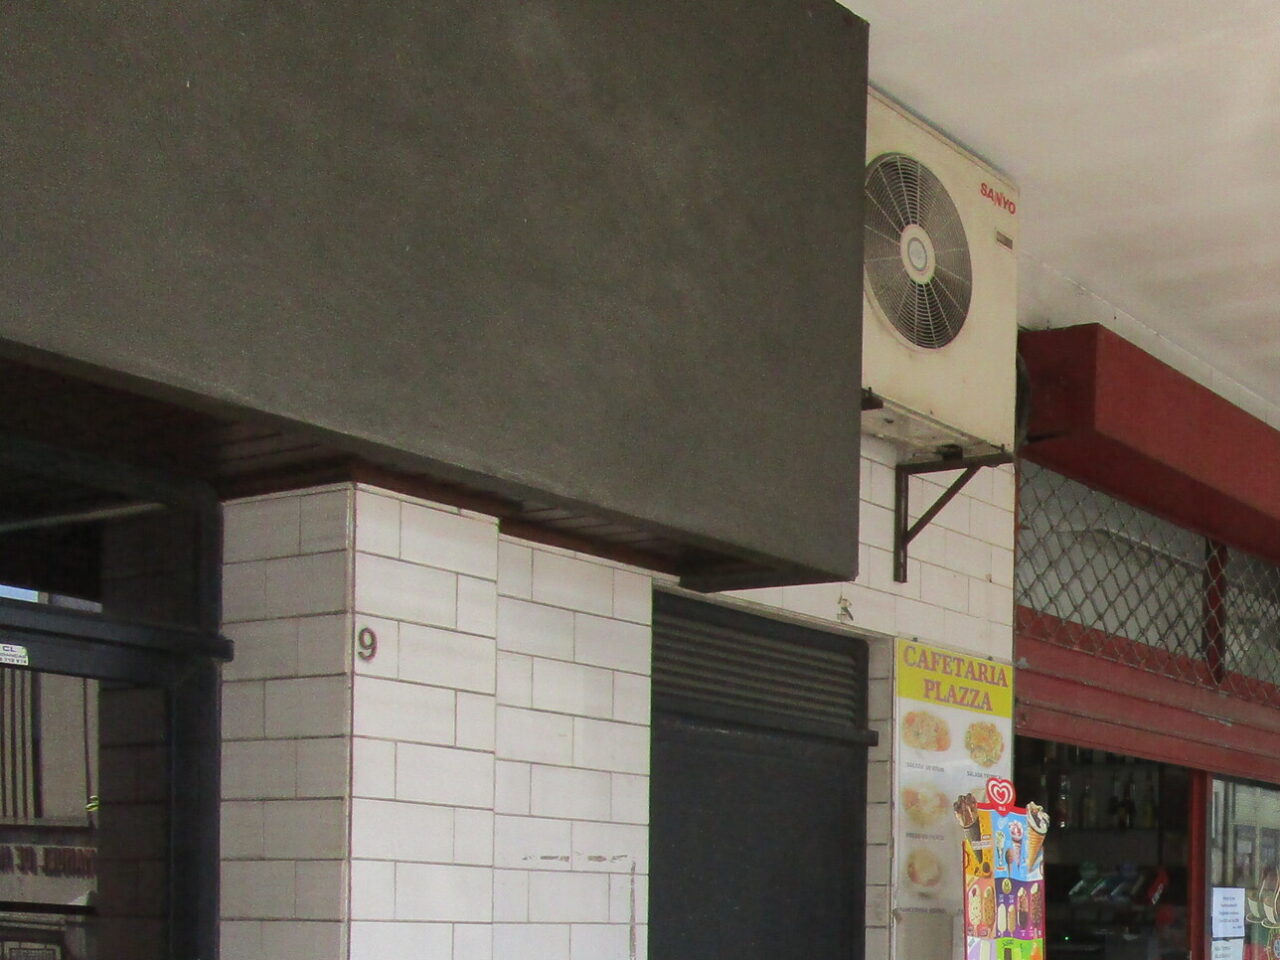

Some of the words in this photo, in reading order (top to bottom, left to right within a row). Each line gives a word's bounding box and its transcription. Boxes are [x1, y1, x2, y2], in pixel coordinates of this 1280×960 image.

[980, 182, 1016, 215] SANYO
[358, 627, 377, 661] 9
[903, 645, 1008, 688] CAFETARIA
[923, 678, 993, 712] PLAZZA
